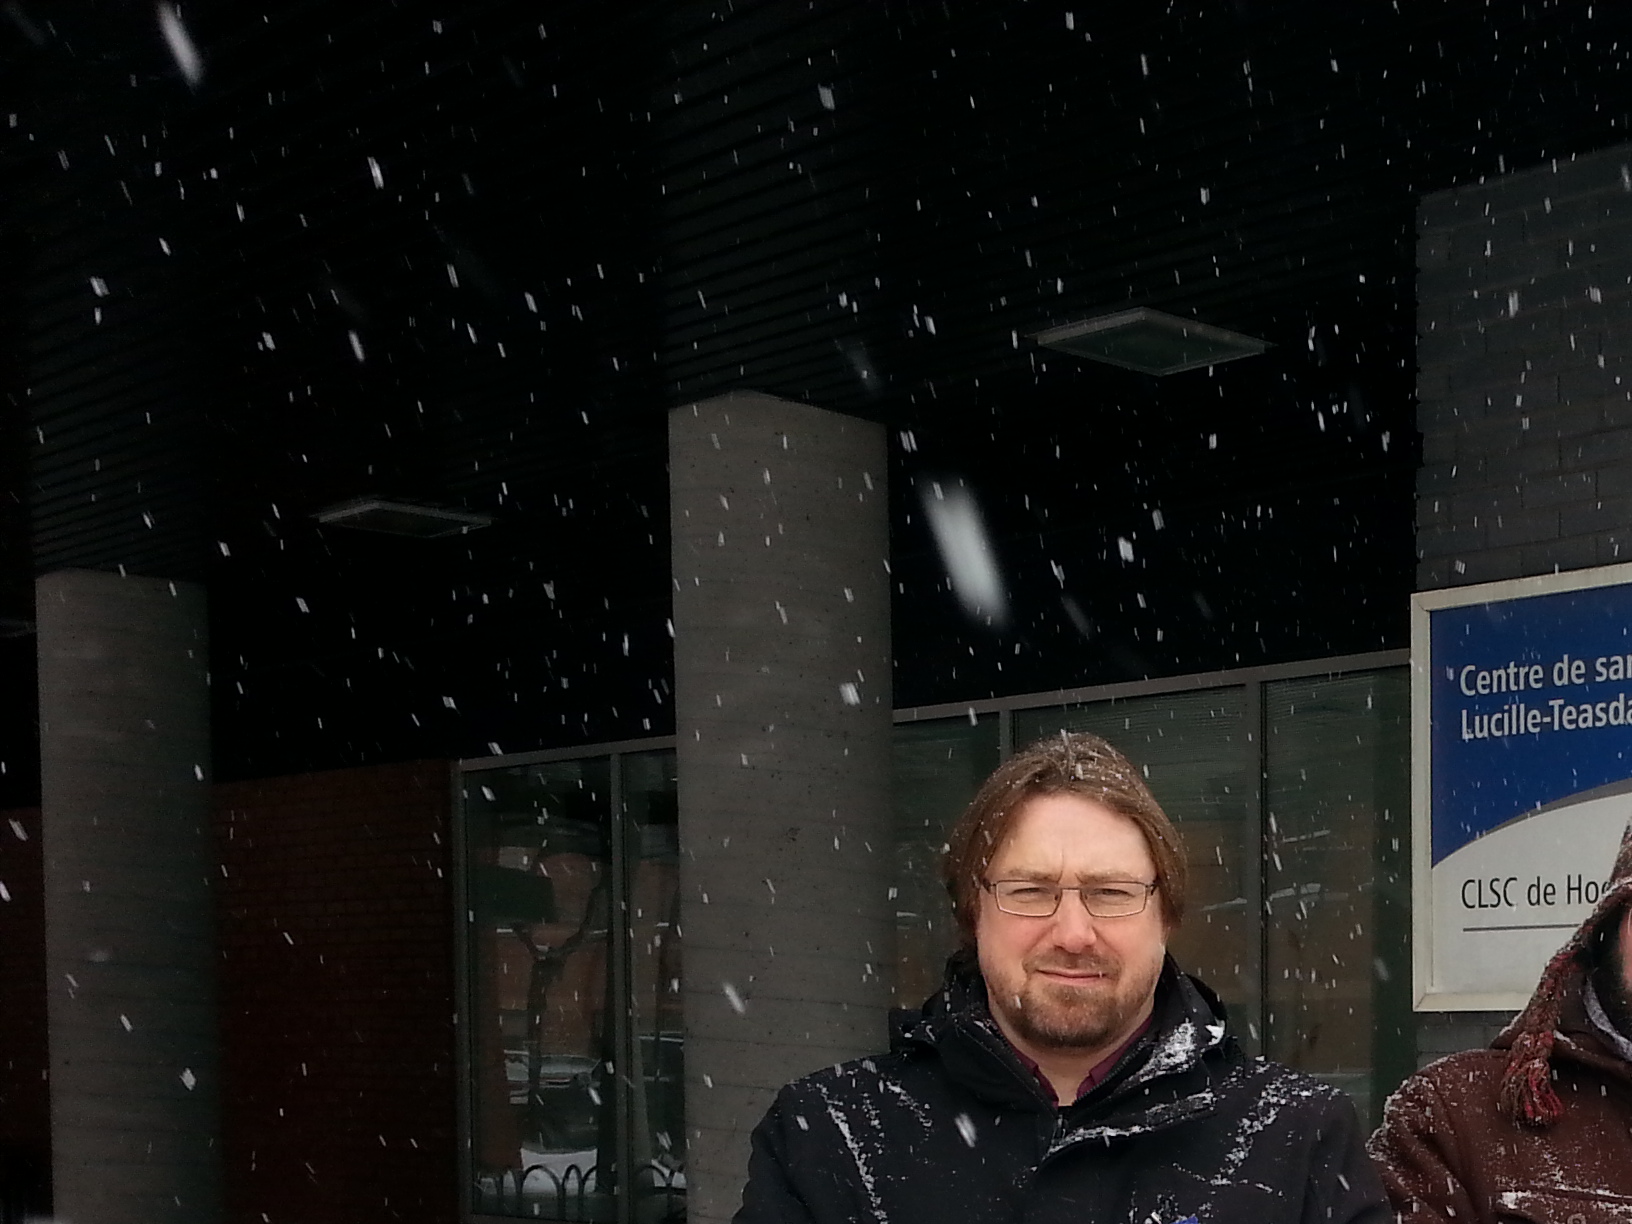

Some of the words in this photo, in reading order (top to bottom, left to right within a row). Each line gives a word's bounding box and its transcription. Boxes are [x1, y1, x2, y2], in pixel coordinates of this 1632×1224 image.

[1460, 661, 1543, 696] Centre
[1553, 654, 1585, 686] de
[1461, 877, 1518, 909] CLSC
[1527, 876, 1556, 906] de
